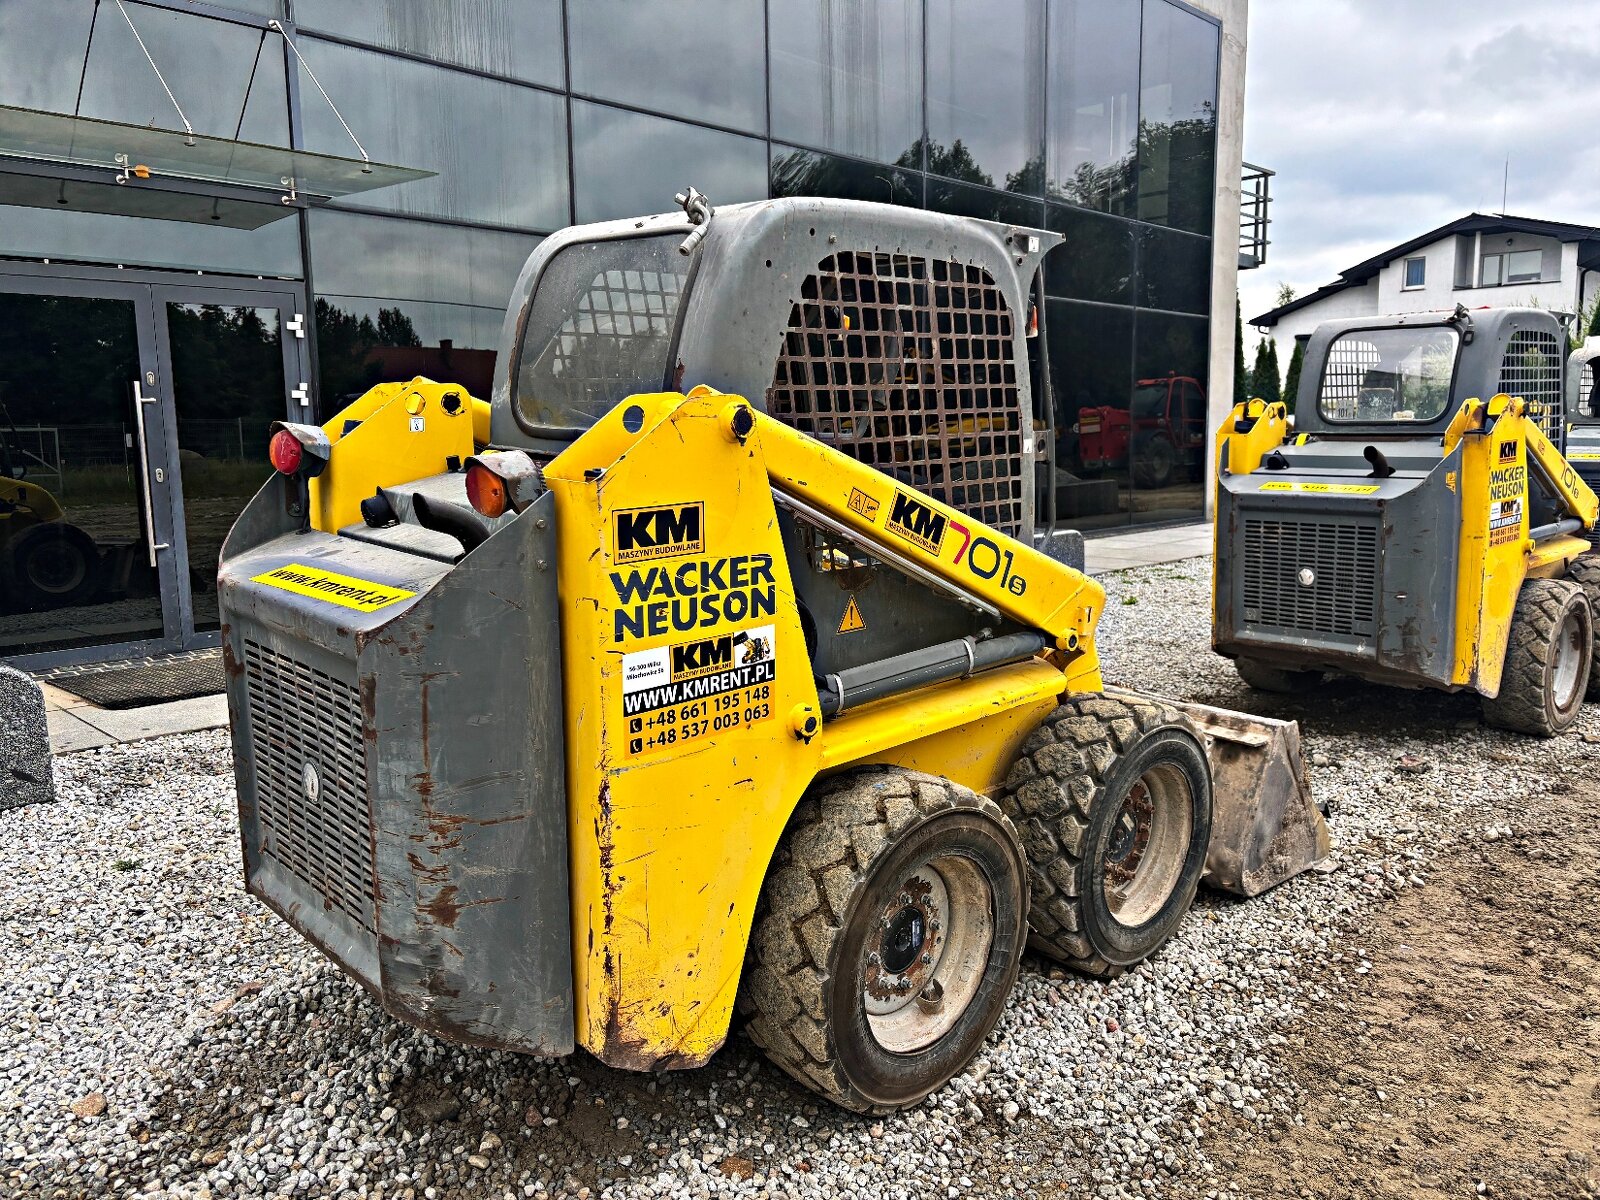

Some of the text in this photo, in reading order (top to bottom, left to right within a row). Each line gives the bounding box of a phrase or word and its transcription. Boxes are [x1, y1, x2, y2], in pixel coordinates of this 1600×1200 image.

[1500, 441, 1517, 458] KM
[1490, 480, 1524, 500] NEUSON
[1491, 466, 1524, 484] WACKER
[617, 506, 699, 550] KM
[891, 492, 946, 544] KM
[618, 541, 700, 560] MASZYNY BUDOWLANE
[269, 570, 400, 606] www.kmrent.pl
[609, 553, 776, 605] WACKER
[614, 585, 776, 643] NEUSON
[673, 636, 732, 673] KM
[673, 662, 732, 681] MASZYNY BUDOWLANE
[624, 664, 774, 714] WWW.KMRENT.PL
[645, 685, 770, 730] +48 661 195 148
[645, 703, 770, 749] +48 537 003 063
